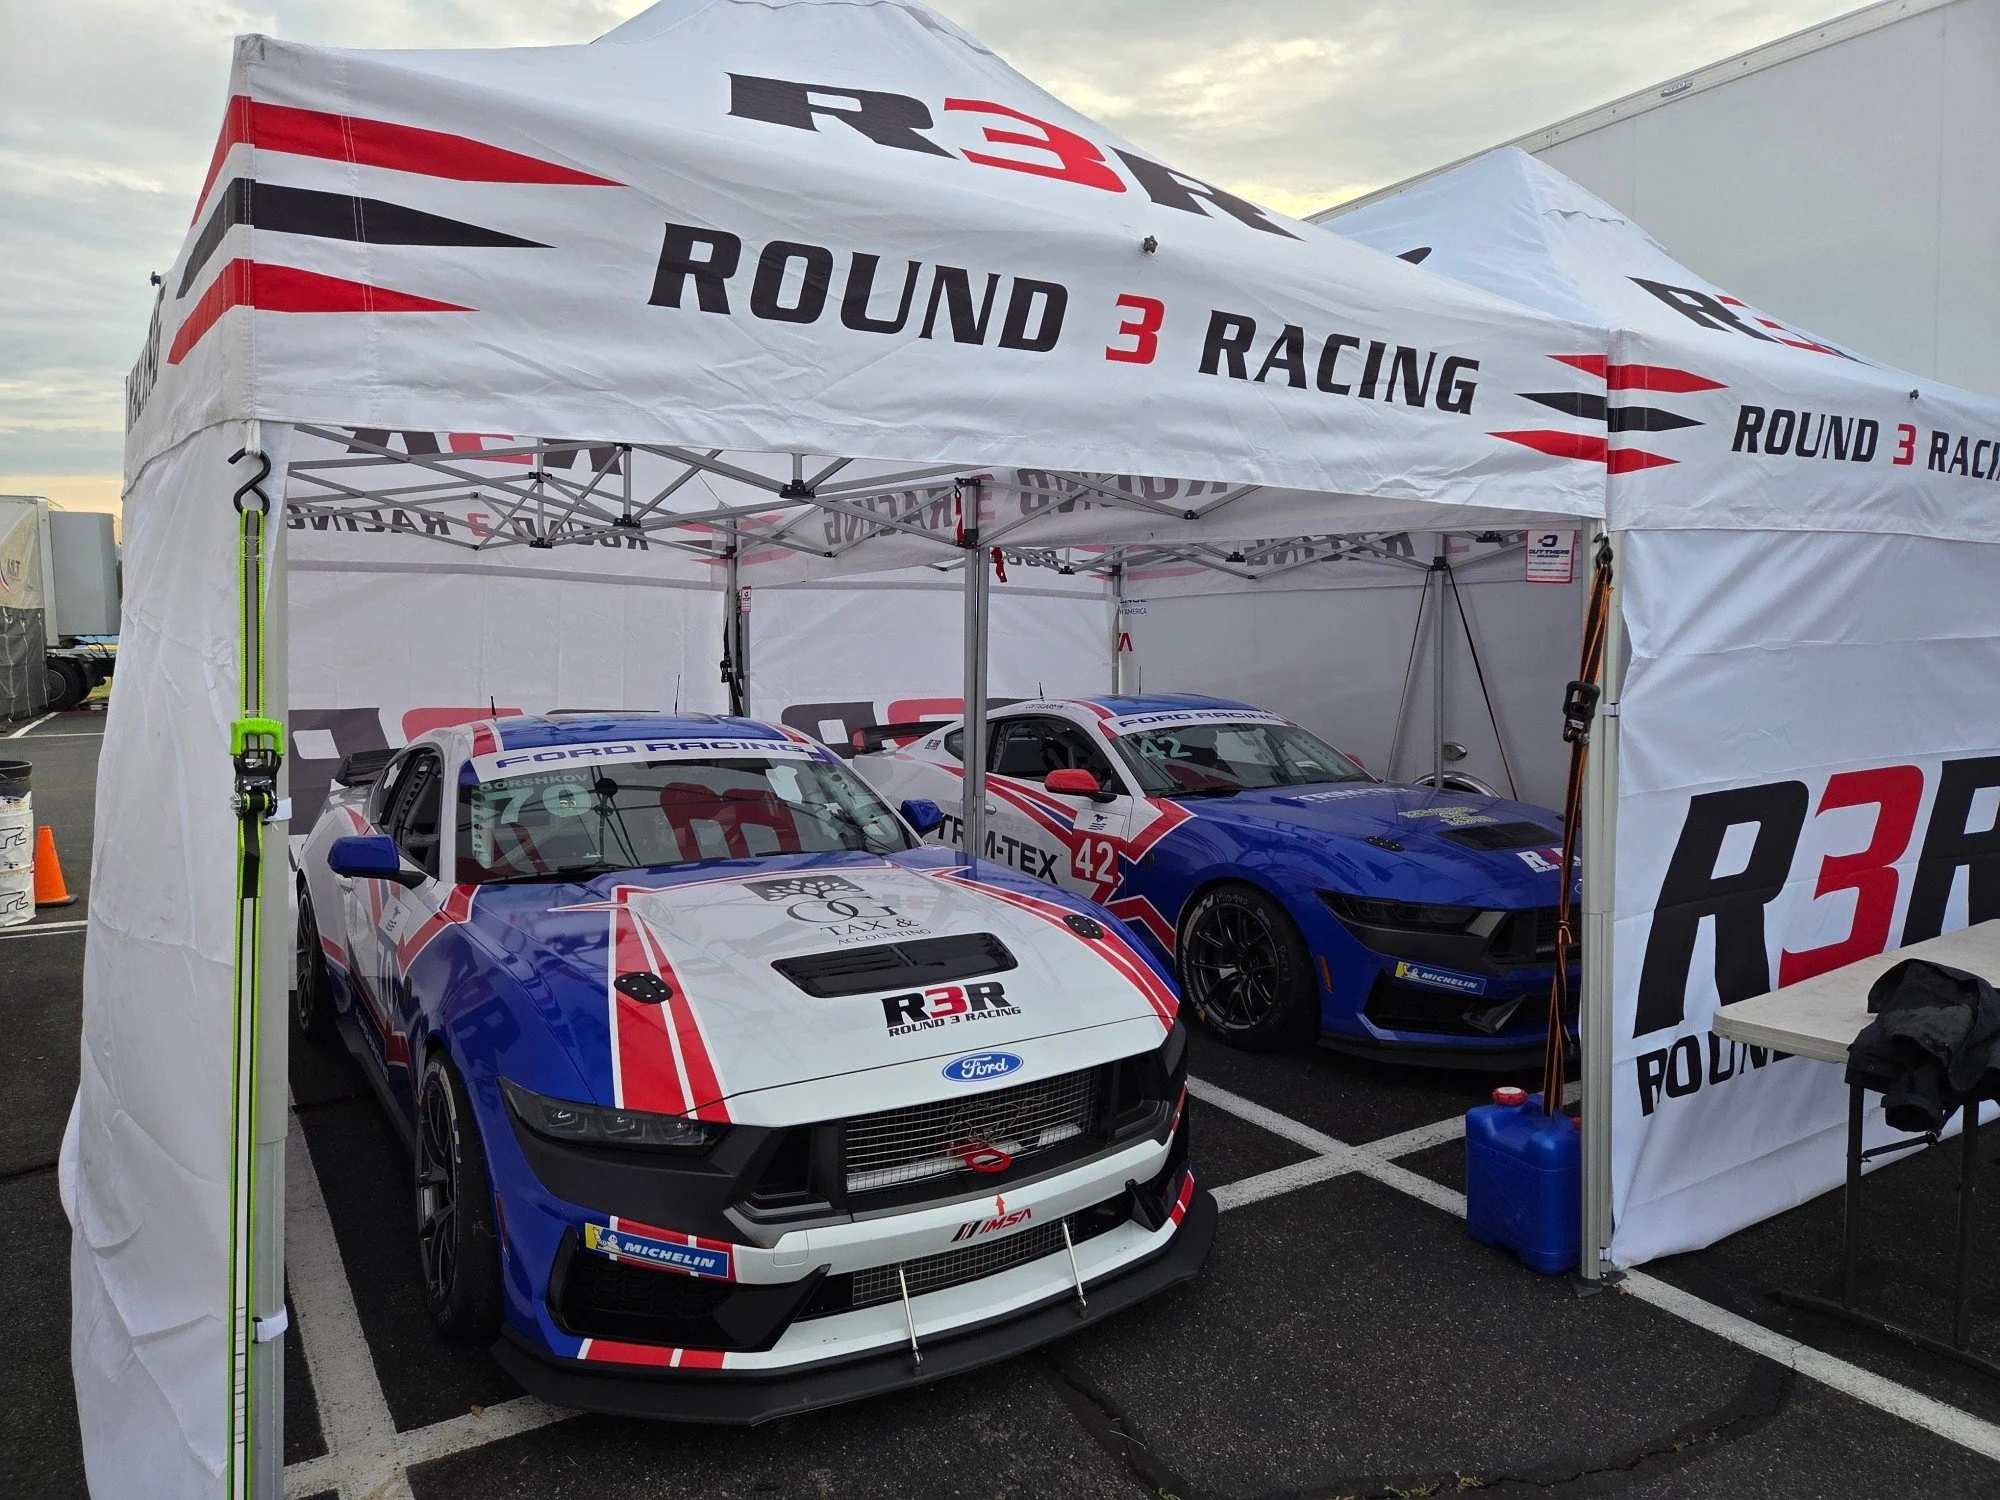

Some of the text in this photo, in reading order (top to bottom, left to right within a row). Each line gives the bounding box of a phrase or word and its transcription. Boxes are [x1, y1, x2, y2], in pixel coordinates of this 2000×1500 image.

[725, 71, 1306, 241] R3R
[647, 222, 1480, 416] ROUND 3 RACING
[1731, 404, 2000, 482] ROUND 3 RACI
[1118, 712, 1283, 728] FORD RACING
[496, 741, 809, 768] FORD RACING
[1140, 736, 1193, 760] 42
[478, 772, 589, 792] GORSHKOV
[1075, 837, 1114, 884] 42
[820, 917, 920, 936] TAX &
[838, 928, 931, 946] ACCOUNTING
[1420, 971, 1478, 990] MICHELIN
[880, 981, 1012, 1028] R3R
[888, 1006, 1022, 1037] ROUND 3 RACING
[961, 1055, 1009, 1079] Ford
[979, 1207, 1032, 1234] IMSA
[623, 1241, 716, 1269] MICHELIN
